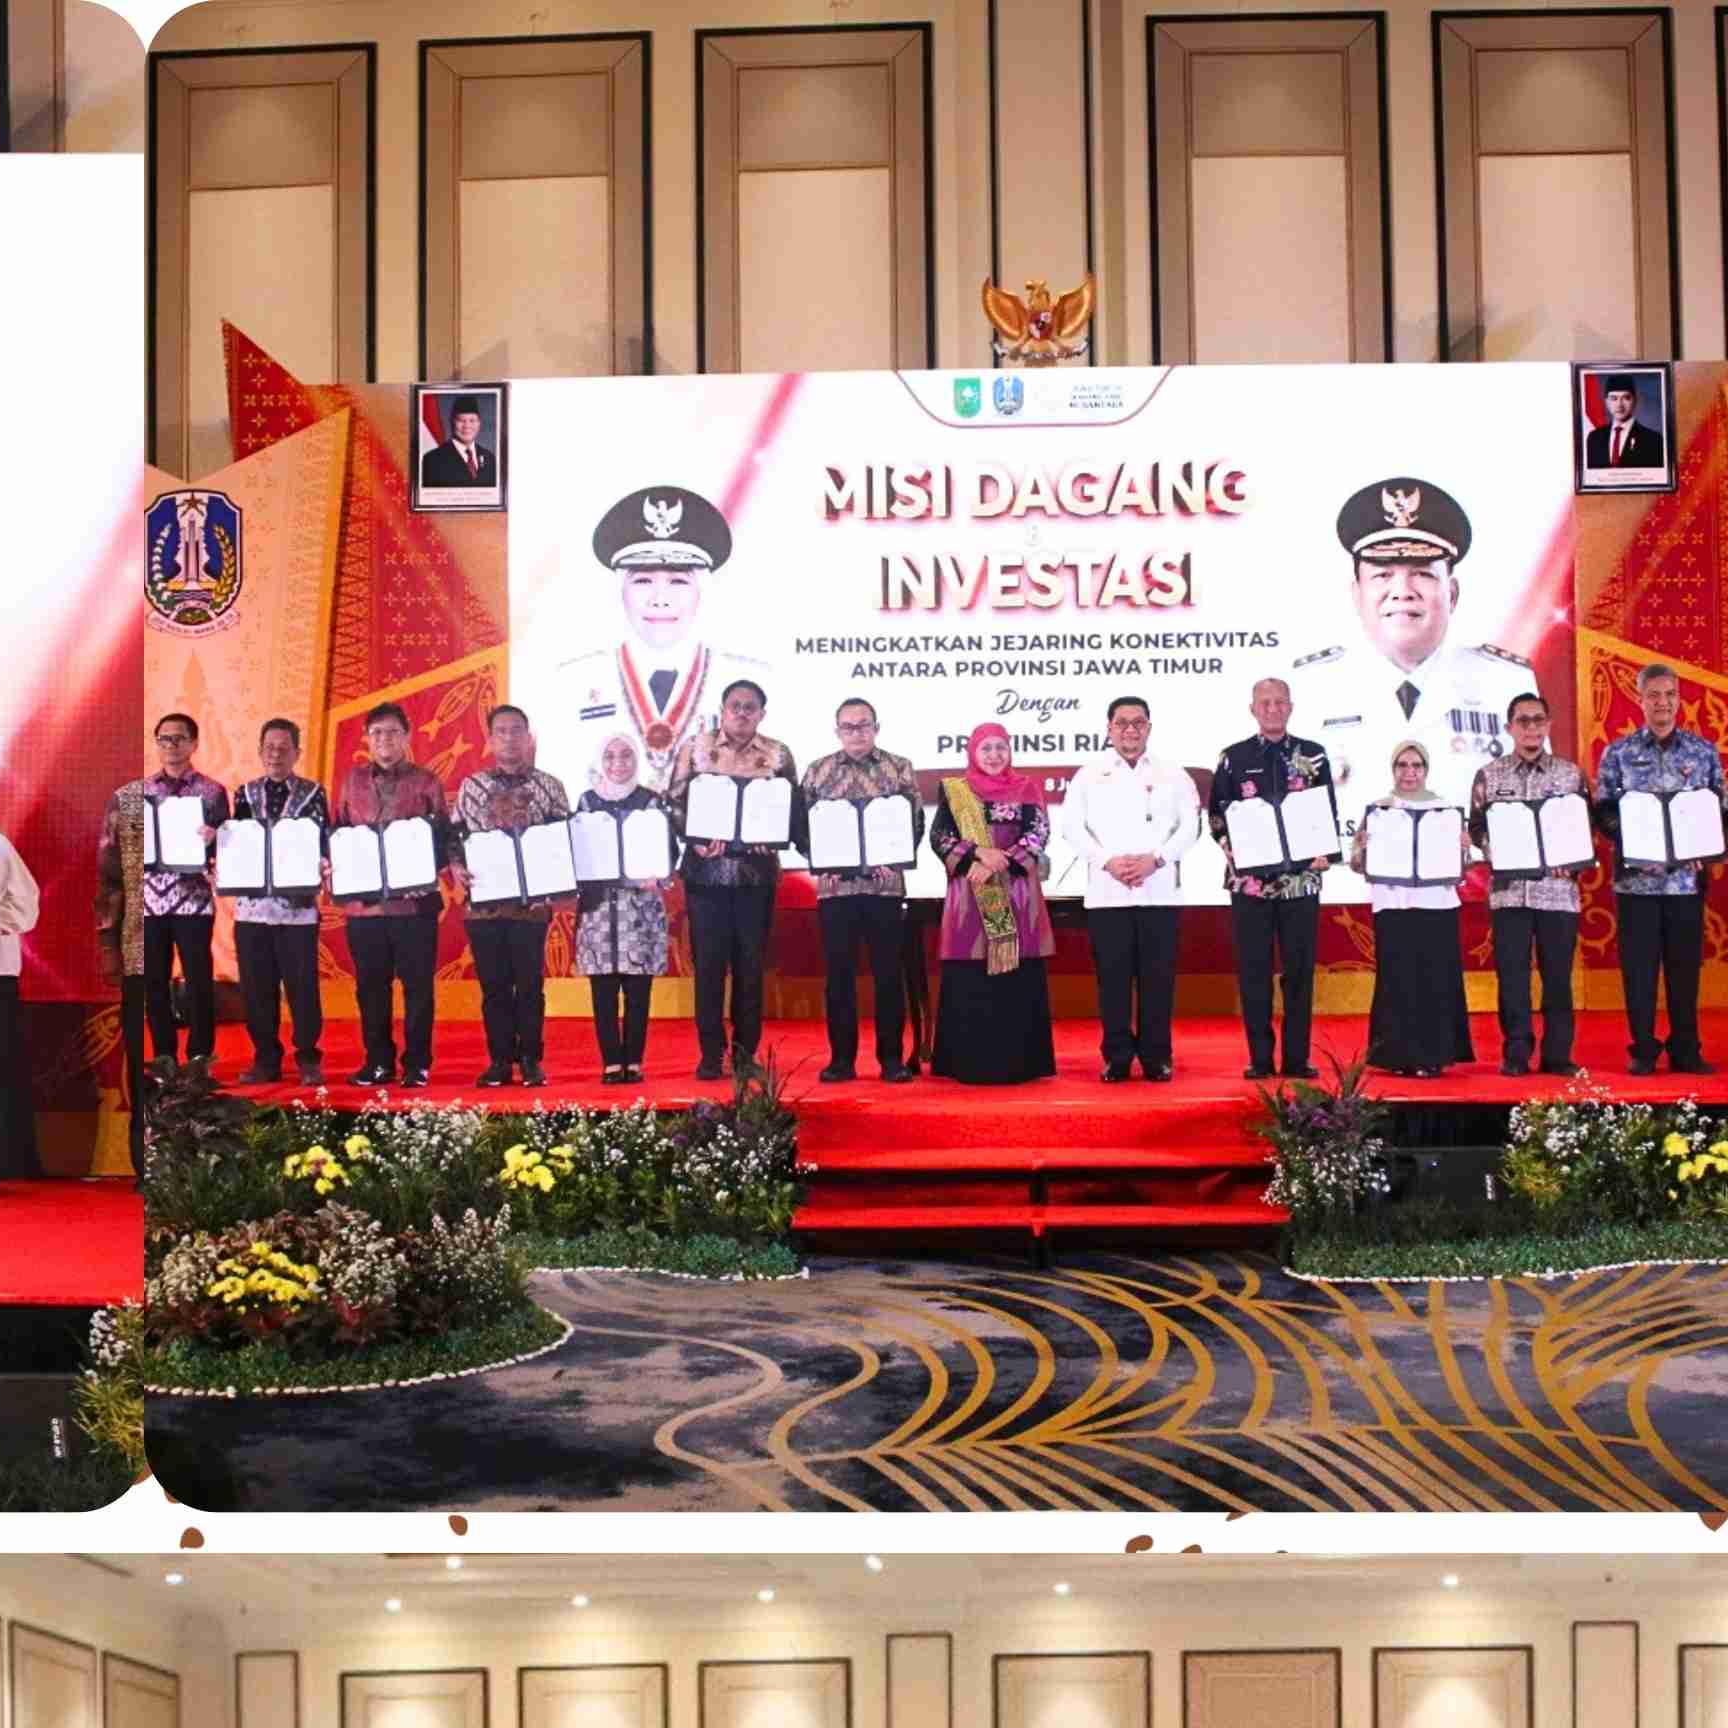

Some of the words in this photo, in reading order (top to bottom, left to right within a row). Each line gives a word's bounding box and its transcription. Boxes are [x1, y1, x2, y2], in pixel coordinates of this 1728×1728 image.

[816, 463, 953, 521] MISI
[969, 459, 1257, 518] DAGANG
[873, 549, 1200, 612] INVESTASI
[795, 635, 983, 654] MENINGKATKAN
[990, 633, 1103, 651] JEJARING
[1110, 631, 1280, 649] KONEKTIVITAS
[851, 661, 948, 679] ANTARA
[955, 659, 1066, 677] PROVINSI
[1073, 658, 1142, 676] JAWA
[1148, 657, 1223, 675] TIMUR
[995, 689, 1083, 721] Dengan
[937, 733, 1065, 753] PRINSI
